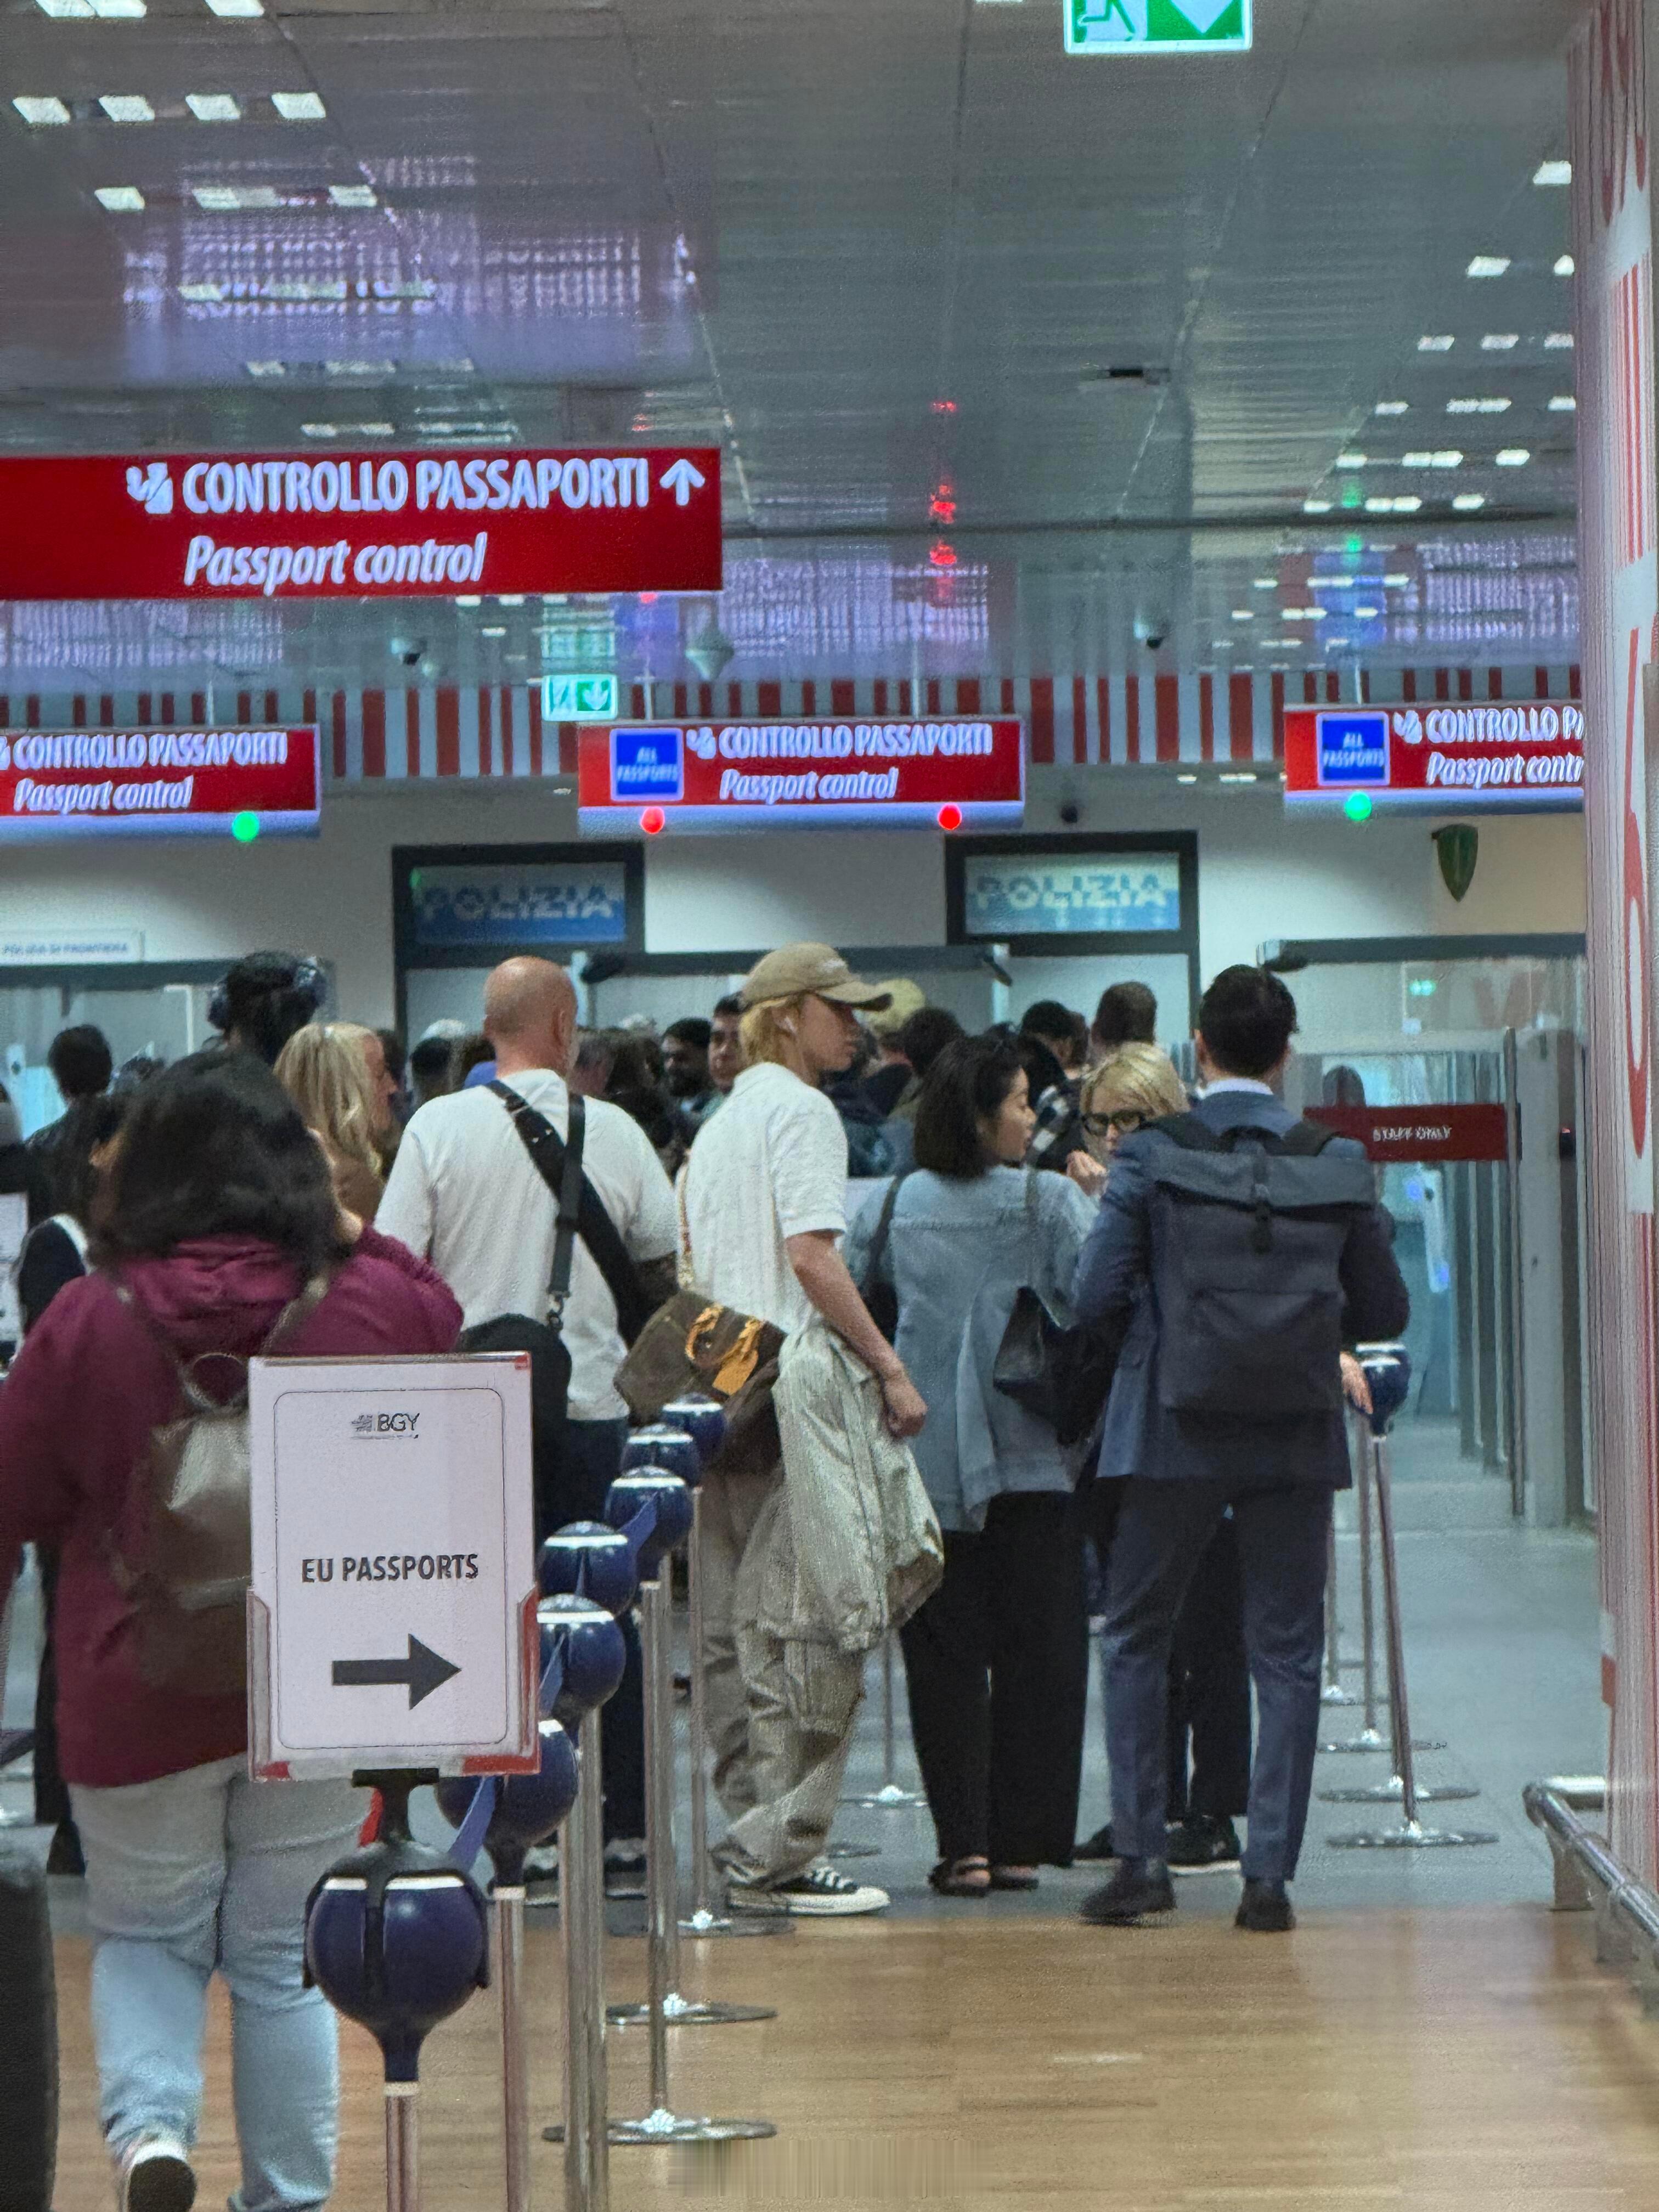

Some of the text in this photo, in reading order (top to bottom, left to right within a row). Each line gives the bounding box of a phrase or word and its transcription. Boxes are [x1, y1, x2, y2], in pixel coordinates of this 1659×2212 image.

[183, 457, 649, 514] CONTROLLO PASSAPORTI
[184, 532, 488, 596] Passport control
[719, 723, 993, 759] CONTROLLO PASSAPORTI
[1342, 732, 1364, 748] ALL
[1426, 706, 1559, 743] CONTROLLO
[13, 731, 288, 770] CONTROLLO PASSAPORTI
[636, 746, 658, 764] ALL
[1323, 749, 1385, 768] PASSPORTS
[617, 764, 678, 783] PASSPORTS
[719, 766, 899, 805] Passport control
[1426, 752, 1524, 789] Passport
[14, 775, 194, 815] Passport control
[424, 885, 614, 921] POLIZIA
[977, 876, 1167, 910] POLIZIA
[377, 1413, 420, 1432] BGY
[302, 1553, 478, 1583] EU PASSPORTS
